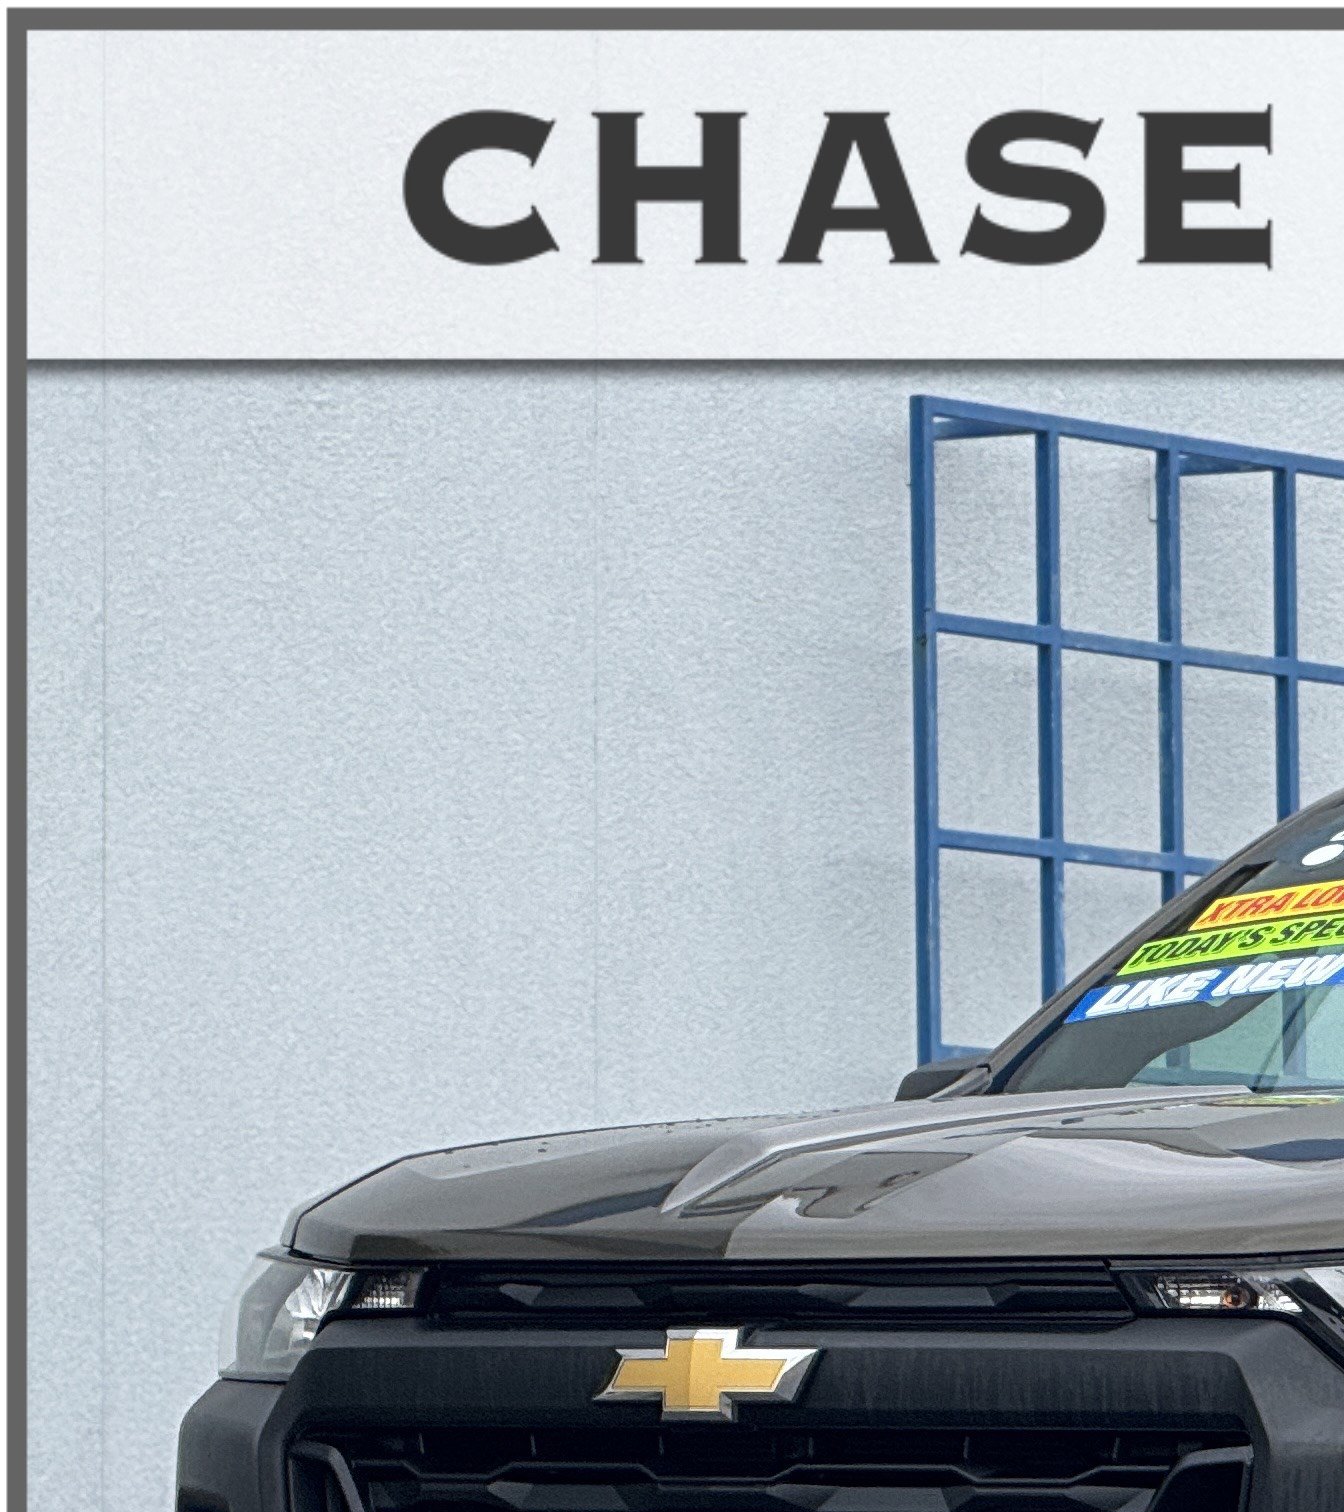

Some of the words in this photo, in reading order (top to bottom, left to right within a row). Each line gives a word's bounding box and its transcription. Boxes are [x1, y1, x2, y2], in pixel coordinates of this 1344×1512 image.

[1200, 894, 1293, 926] XTRA
[1130, 926, 1274, 967] TODAY'S
[1085, 968, 1224, 1019] LIKE
